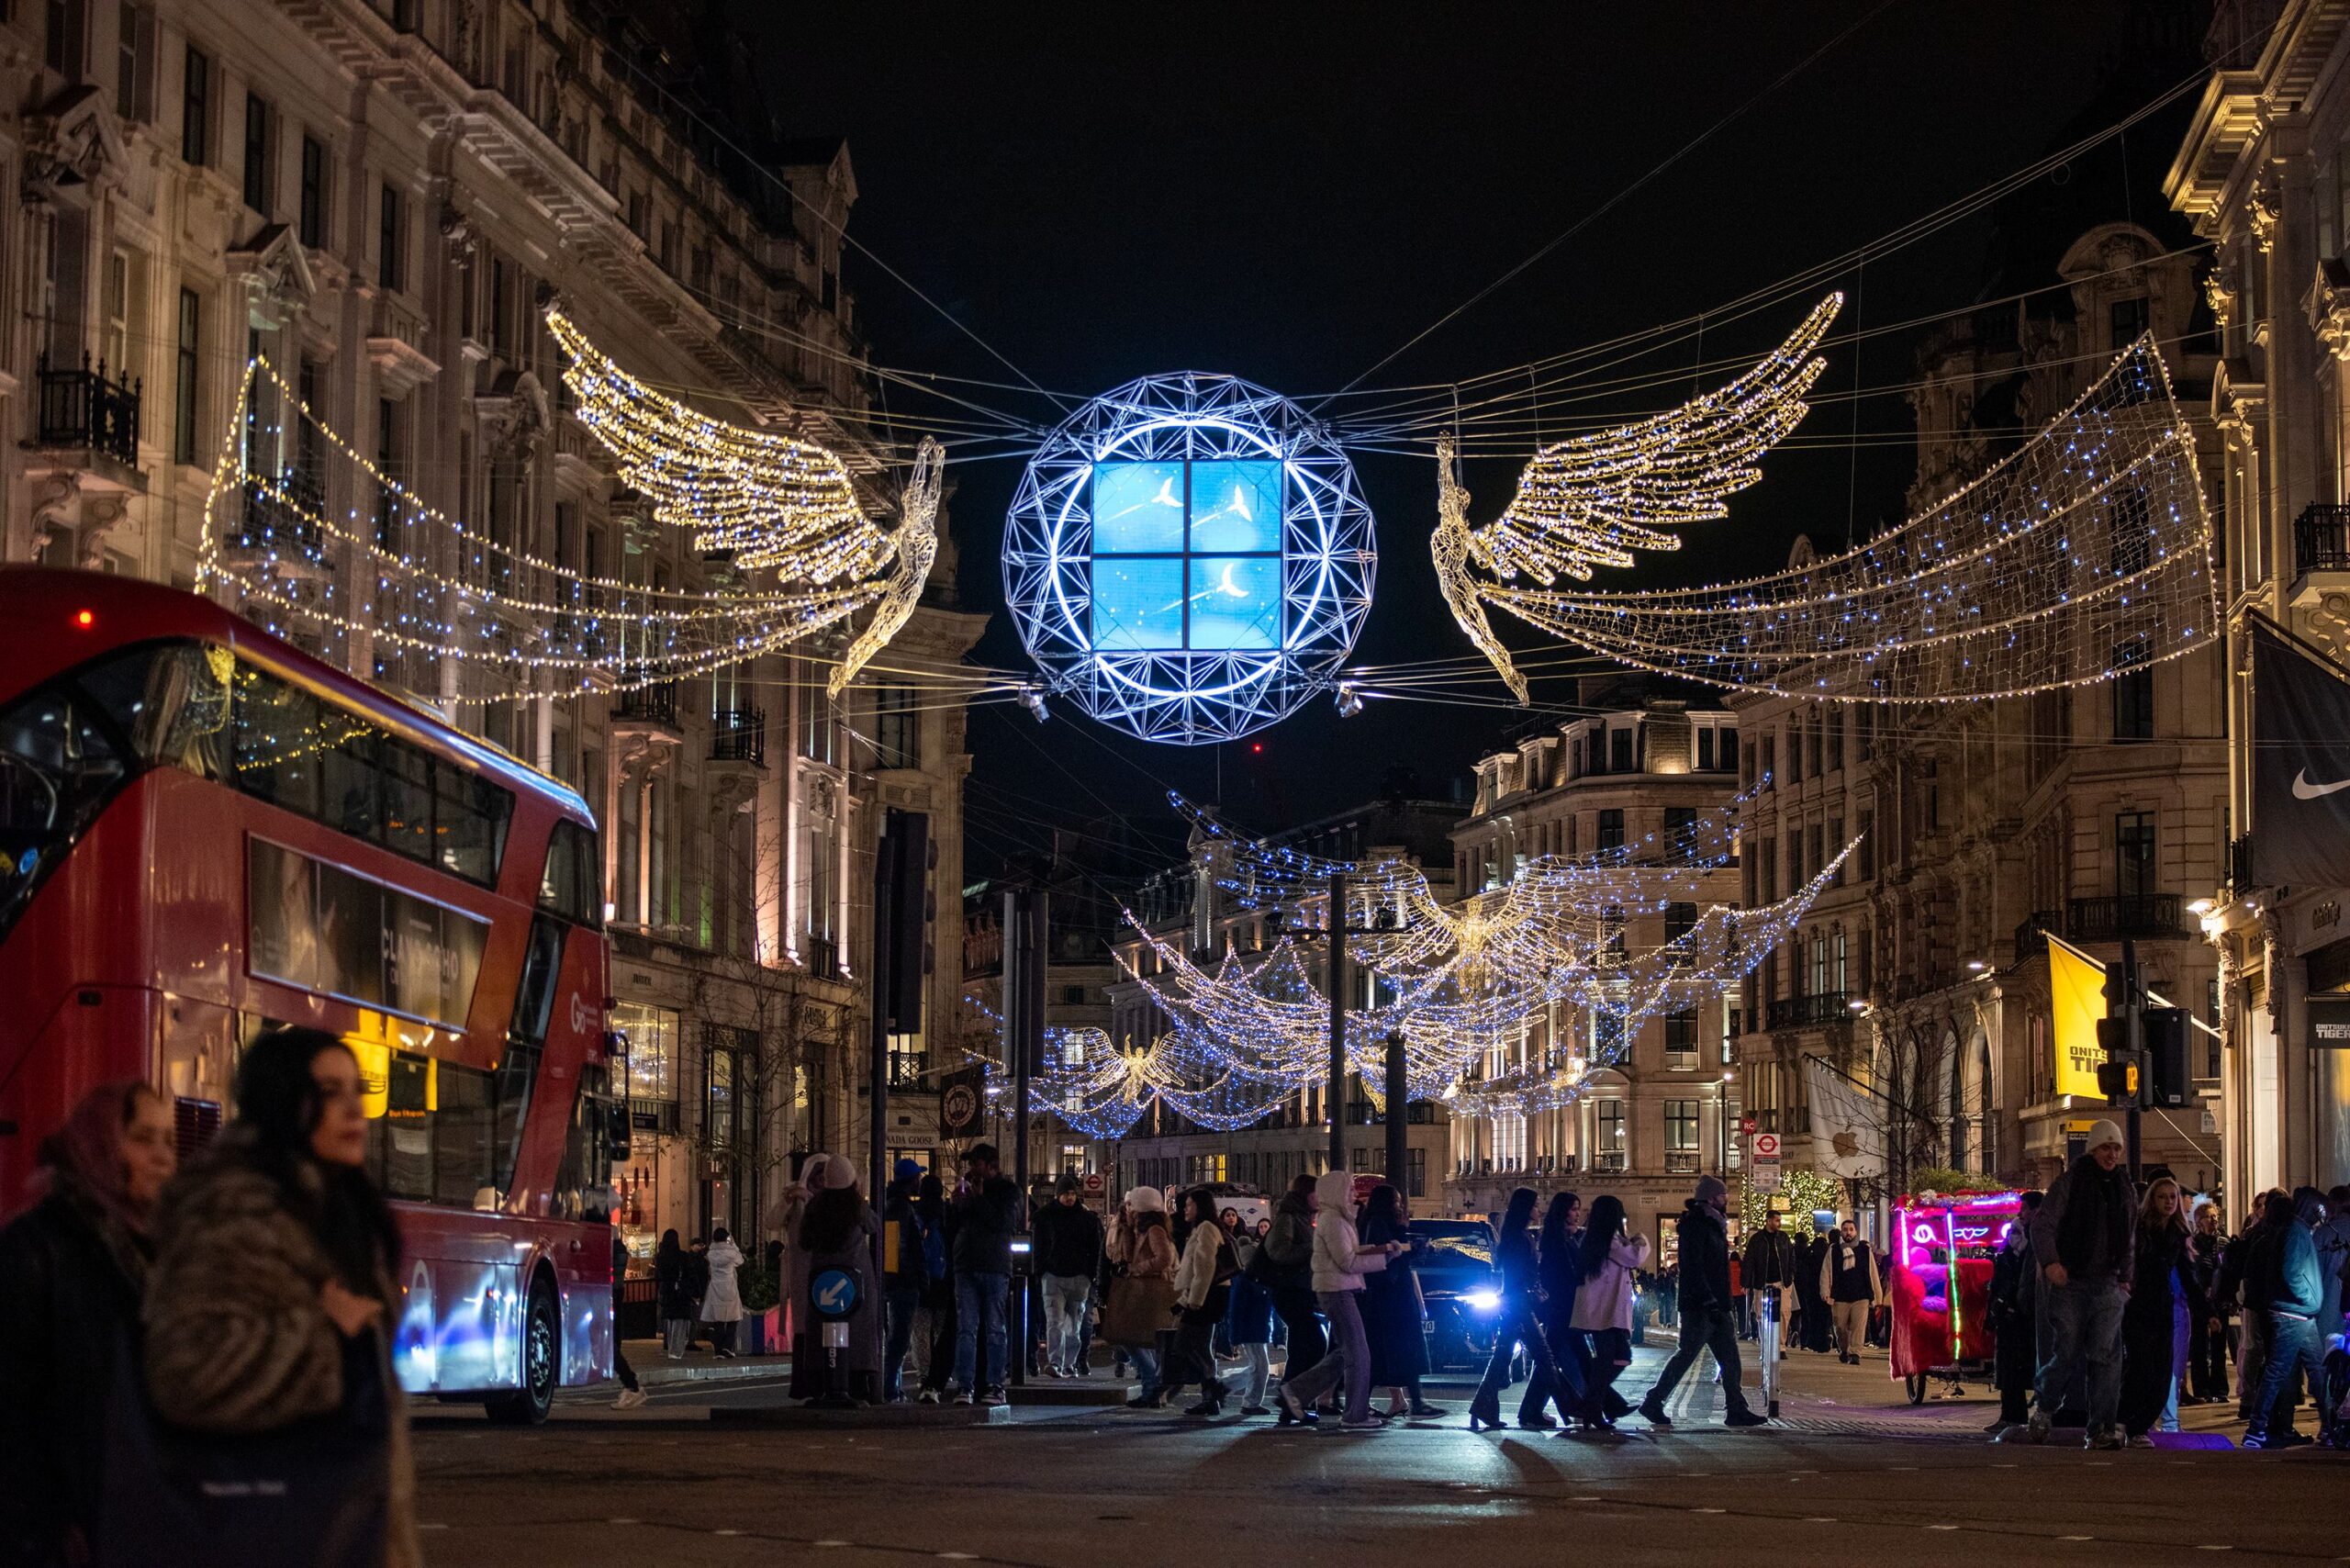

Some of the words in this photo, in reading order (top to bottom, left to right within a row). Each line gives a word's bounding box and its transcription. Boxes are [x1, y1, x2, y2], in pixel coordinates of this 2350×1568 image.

[2316, 1029, 2350, 1038] TIGER
[2070, 1047, 2108, 1058] ONITS
[887, 1136, 906, 1145] NADA
[909, 1136, 934, 1146] GOOSE
